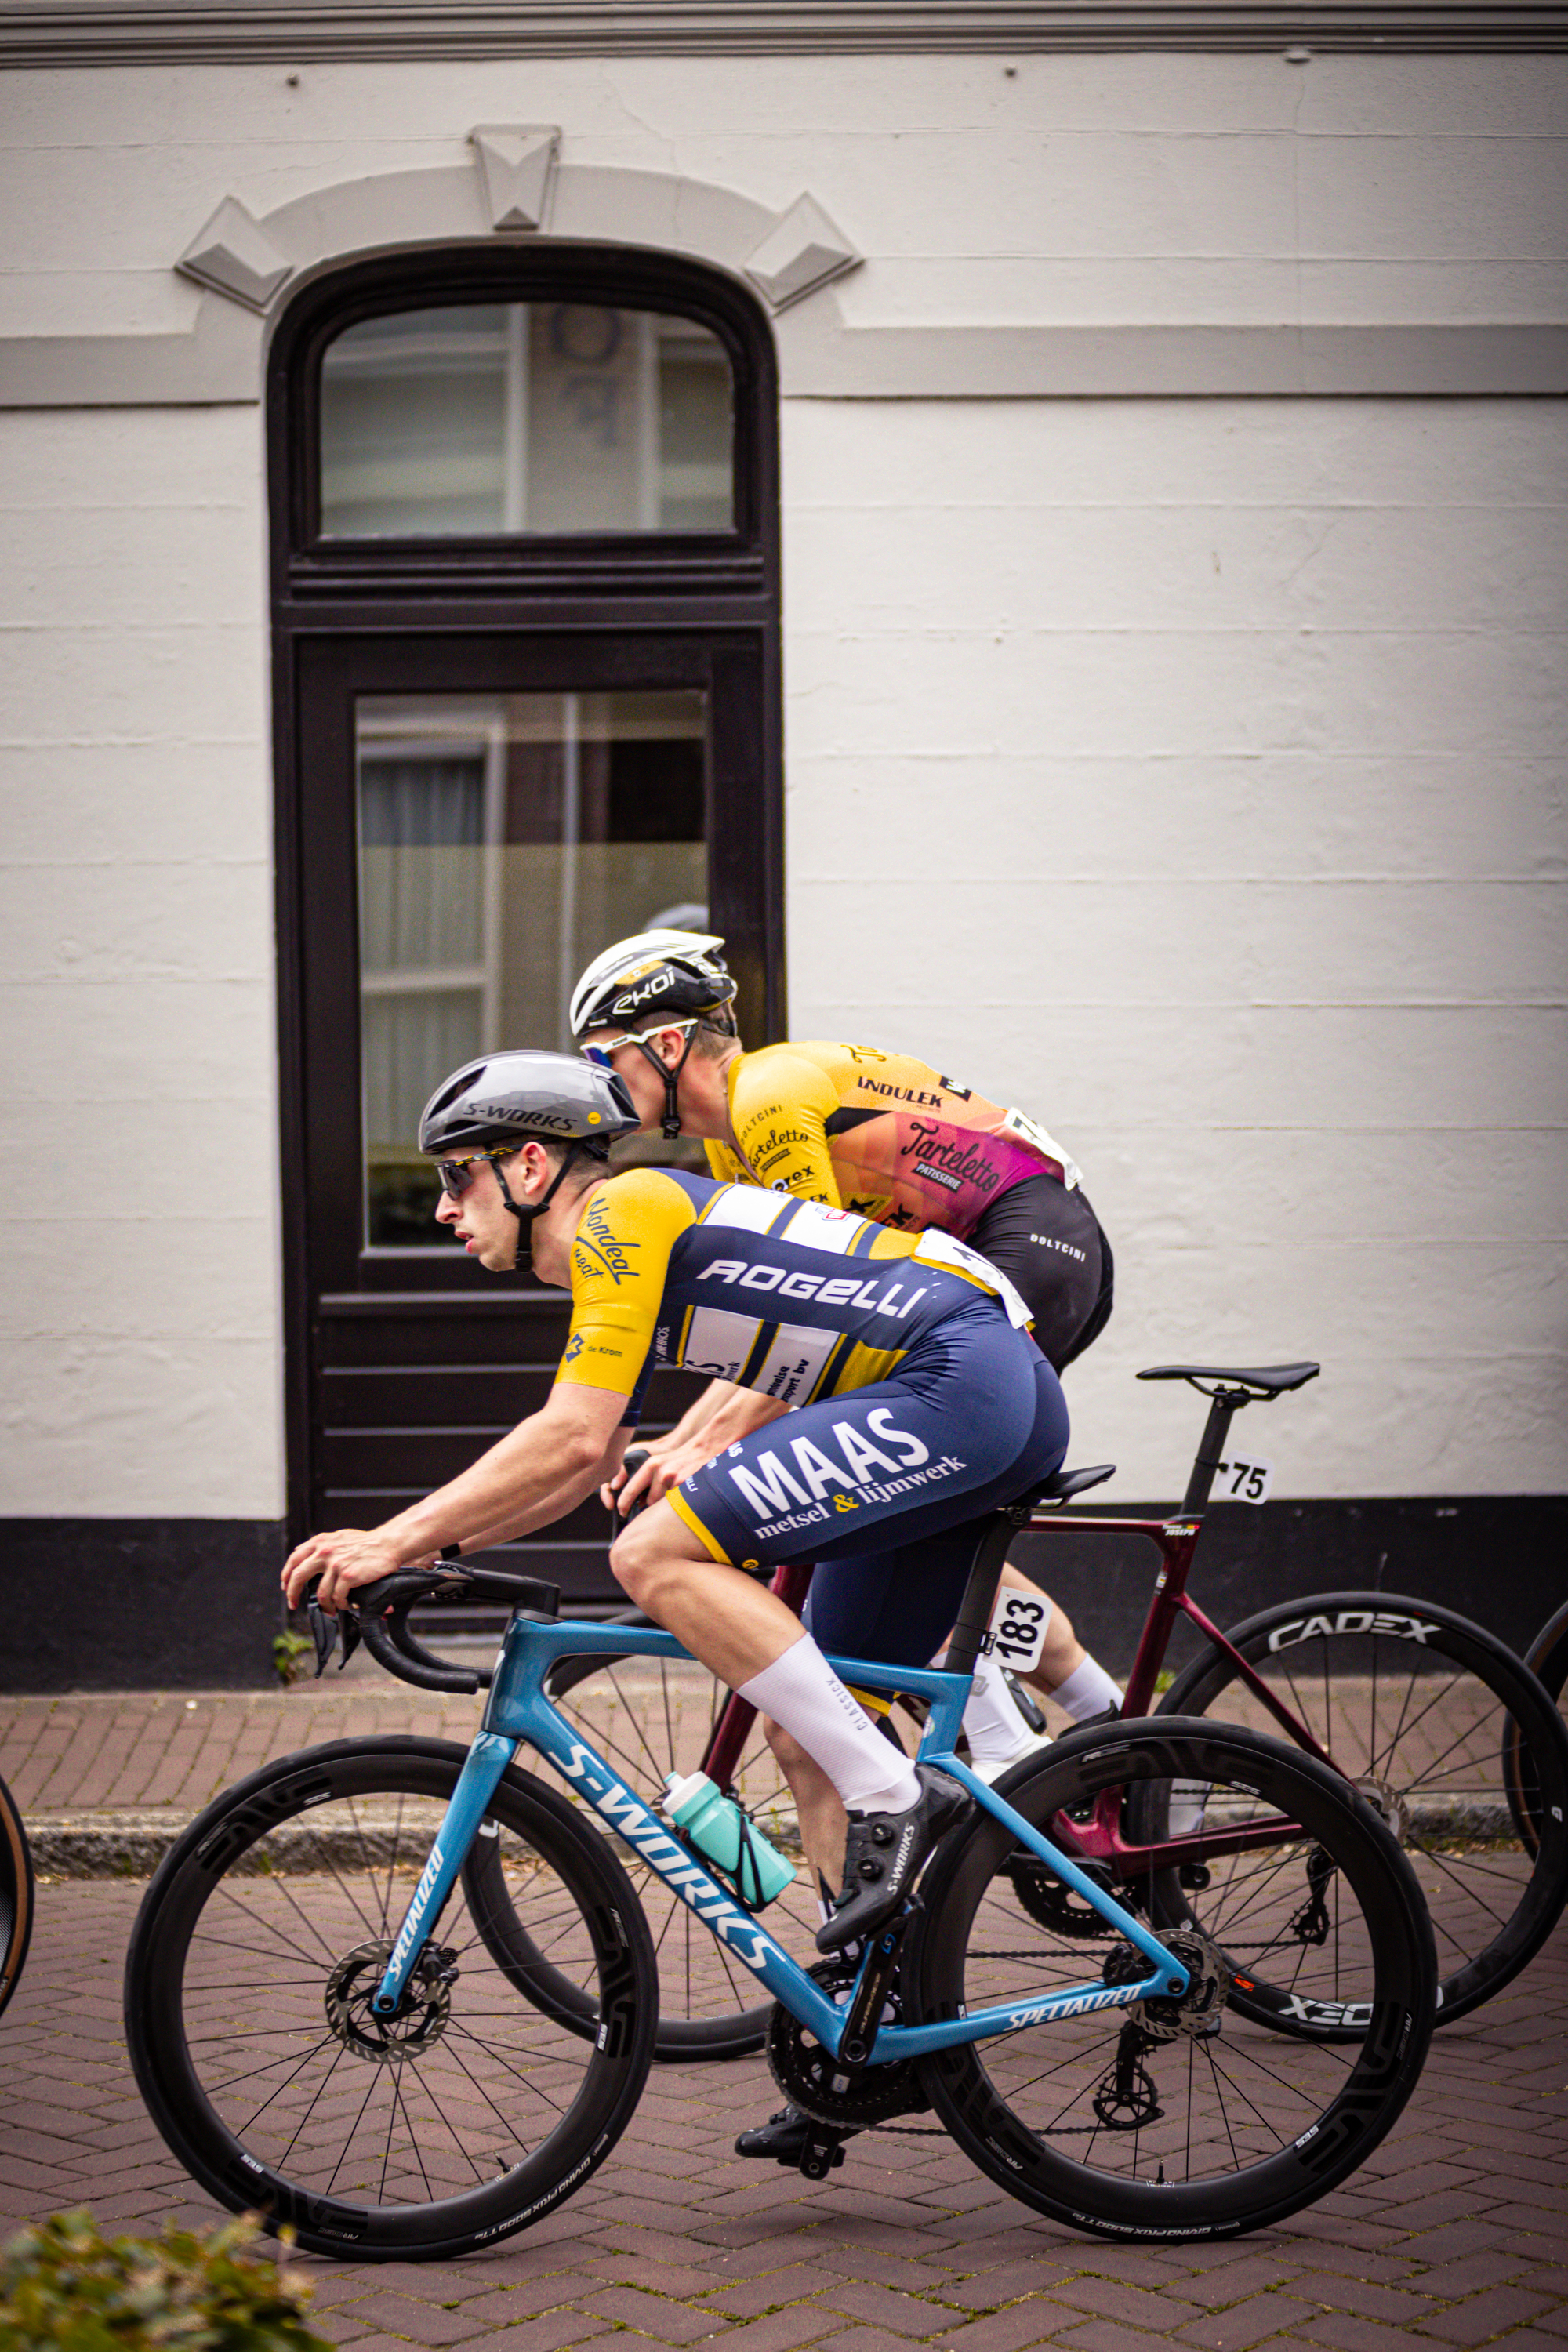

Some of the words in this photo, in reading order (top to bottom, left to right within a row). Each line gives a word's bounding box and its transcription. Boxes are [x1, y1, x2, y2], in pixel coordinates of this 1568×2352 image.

[858, 1076, 944, 1107] INDULEK
[463, 1103, 577, 1131] S-WORKS
[901, 1122, 1000, 1192] Tarteletto
[916, 1163, 962, 1190] PATISSERIE
[1030, 1233, 1086, 1262] DOLTCINI
[696, 1259, 928, 1318] ROGELLI
[599, 1346, 622, 1357] Krom
[793, 1359, 809, 1374] bv
[728, 1408, 930, 1520] MAAS
[1230, 1462, 1267, 1499] 75
[753, 1503, 832, 1540] metsel
[833, 1494, 859, 1512] &
[855, 1456, 968, 1504] lijmwerk
[996, 1599, 1044, 1659] 183
[1269, 1612, 1442, 1652] CADEX
[826, 1677, 868, 1731] CLASSICK
[547, 1744, 786, 1969] S-WORKS
[887, 1824, 916, 1895] S-WORKS
[389, 1844, 444, 1982] SPECIALIZED
[1004, 1986, 1142, 2031] SPECIALIZED
[1278, 1994, 1374, 2026] DEX
[1294, 2125, 1319, 2149] SES
[532, 2188, 558, 2213] PRIX
[499, 2207, 532, 2232] 5000
[1095, 2220, 1134, 2234] 5000
[1134, 2227, 1167, 2237] PRIX
